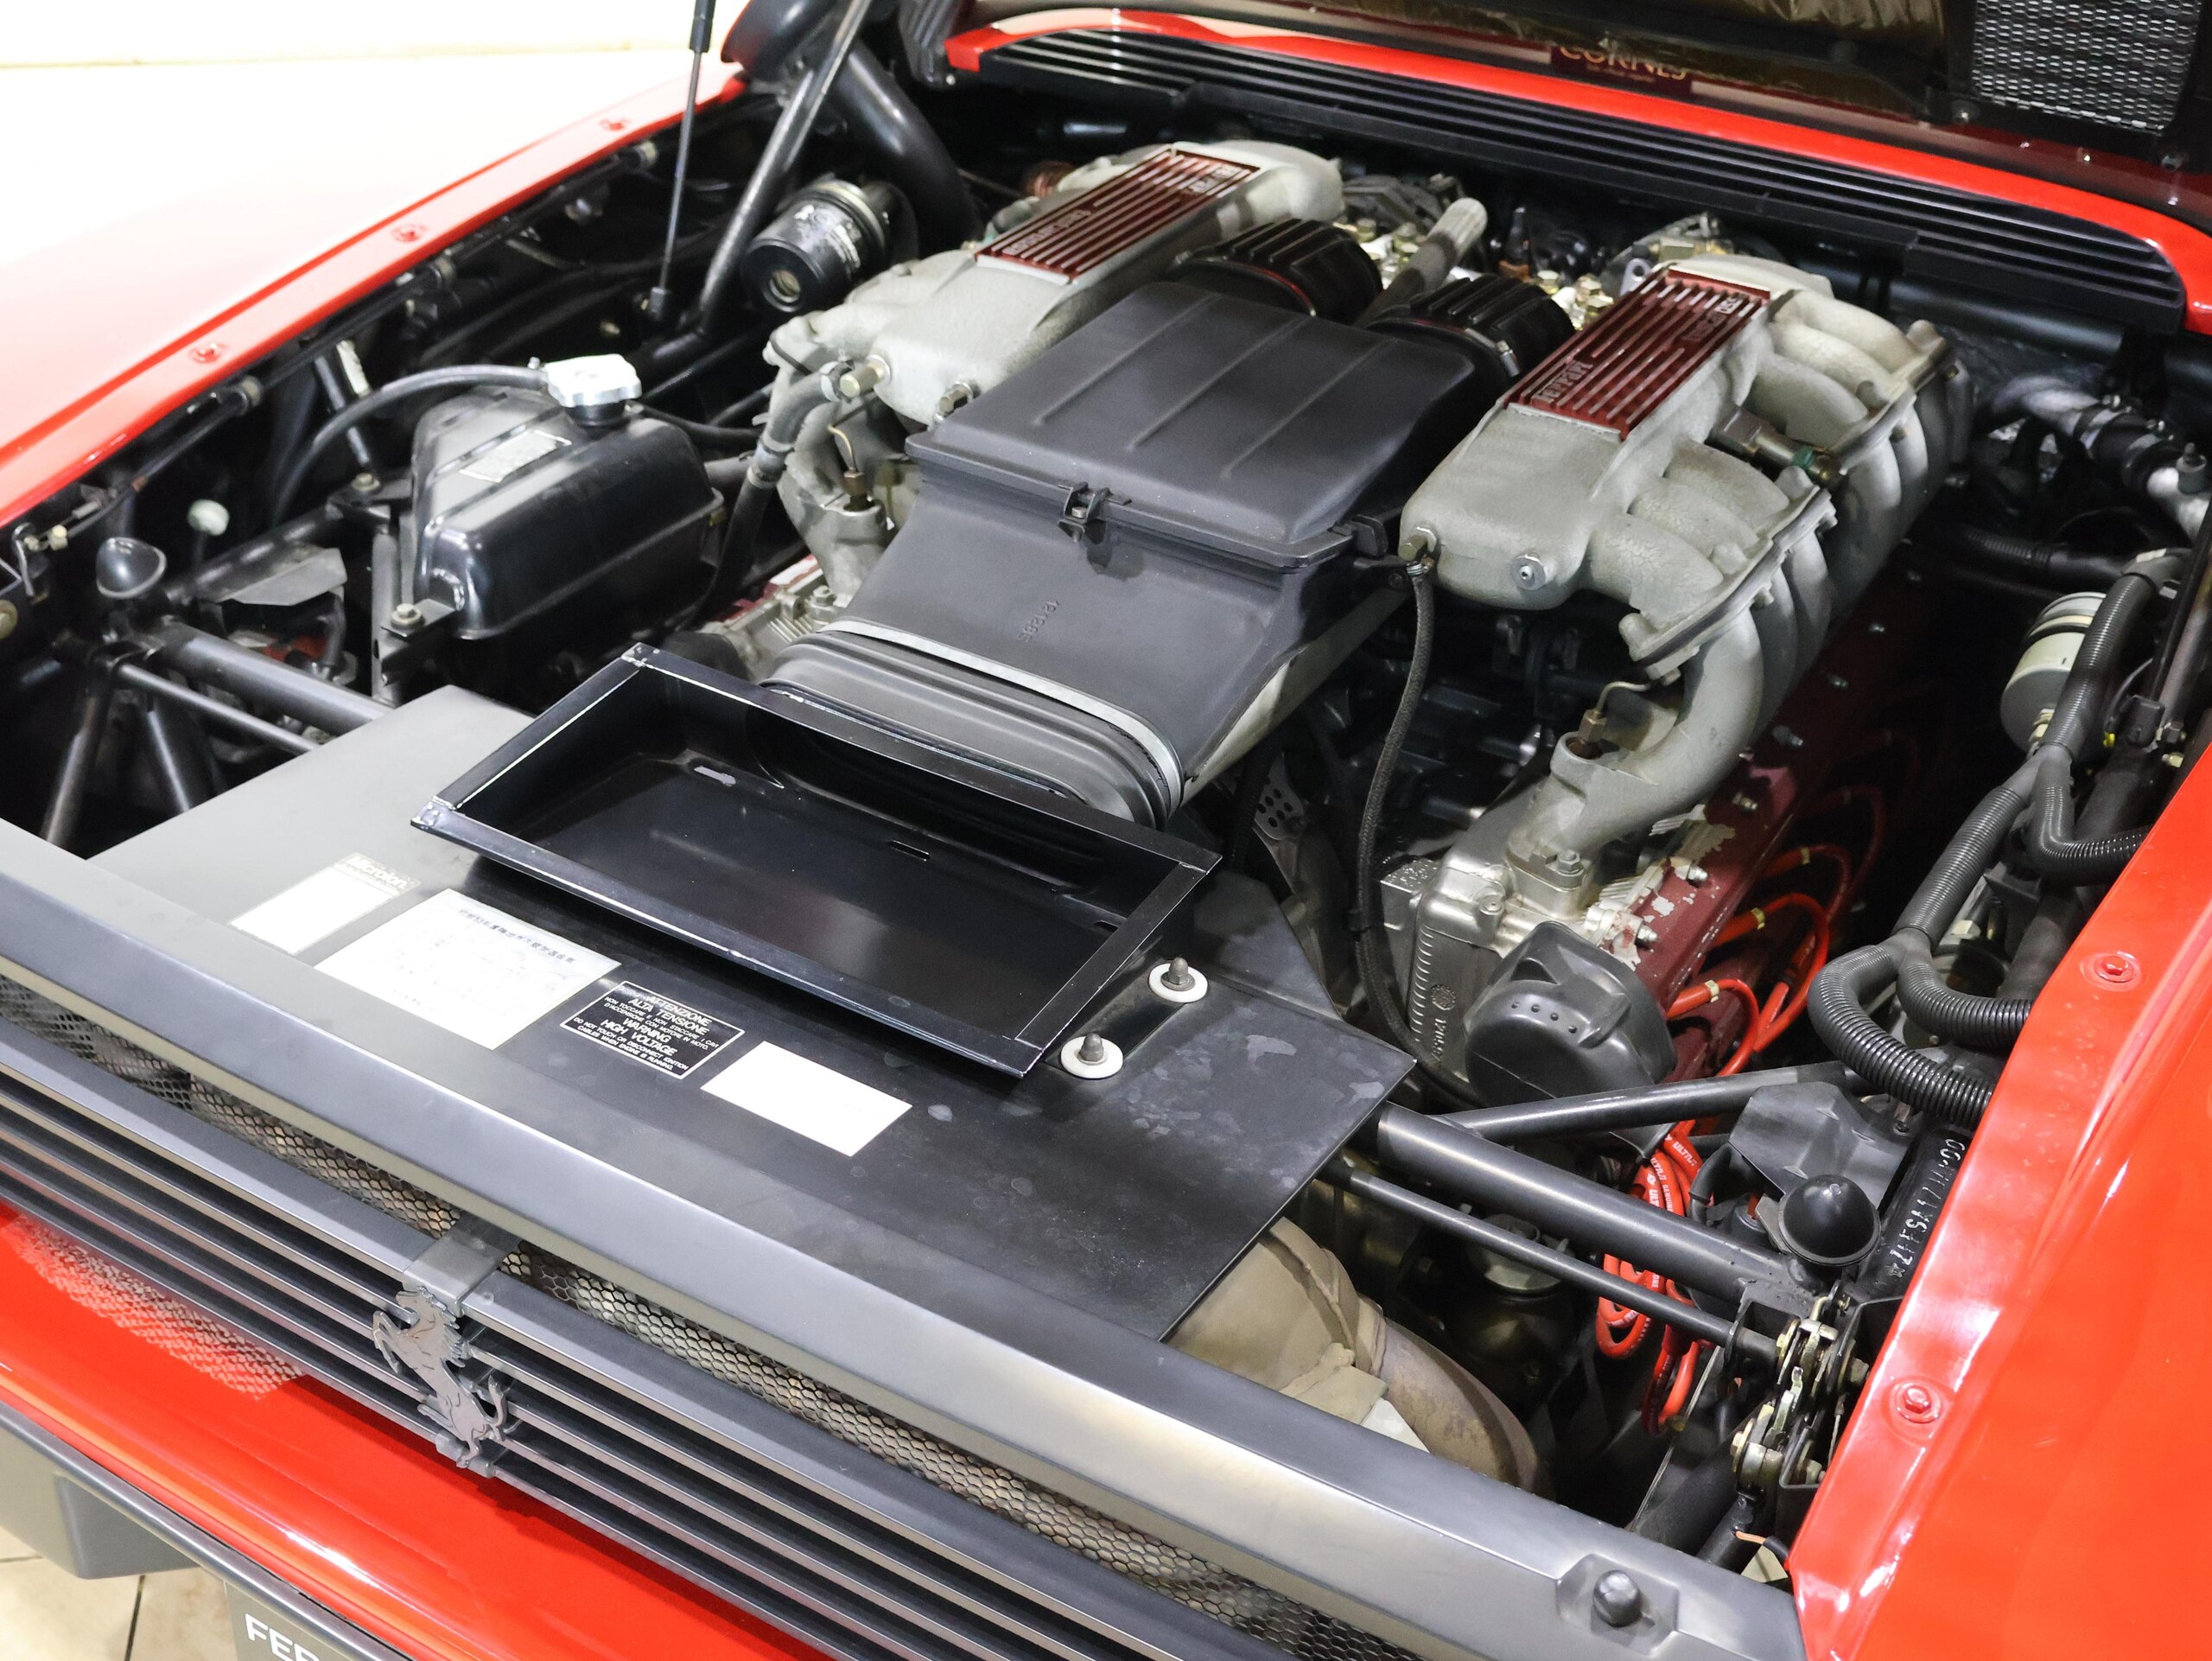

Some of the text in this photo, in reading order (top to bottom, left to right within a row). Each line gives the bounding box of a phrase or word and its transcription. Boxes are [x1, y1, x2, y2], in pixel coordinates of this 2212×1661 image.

[604, 996, 619, 1005] NON
[619, 1002, 646, 1016] TOCCARE
[652, 1017, 668, 1026] NON
[670, 1025, 700, 1040] STACCARE
[622, 1017, 672, 1043] WARNING
[627, 997, 710, 1035] ALTA TENSIONE
[645, 1020, 659, 1028] CON
[658, 1026, 683, 1039] MOTORE
[577, 1025, 601, 1037] CABLES
[601, 1035, 620, 1046] WHEN
[618, 1043, 641, 1055] ENGINE
[596, 1027, 617, 1039] TOUCH
[626, 1041, 664, 1059] DISCONNECT
[663, 1057, 690, 1070] IGNITION
[600, 1019, 678, 1056] HIGH VOLTAGE
